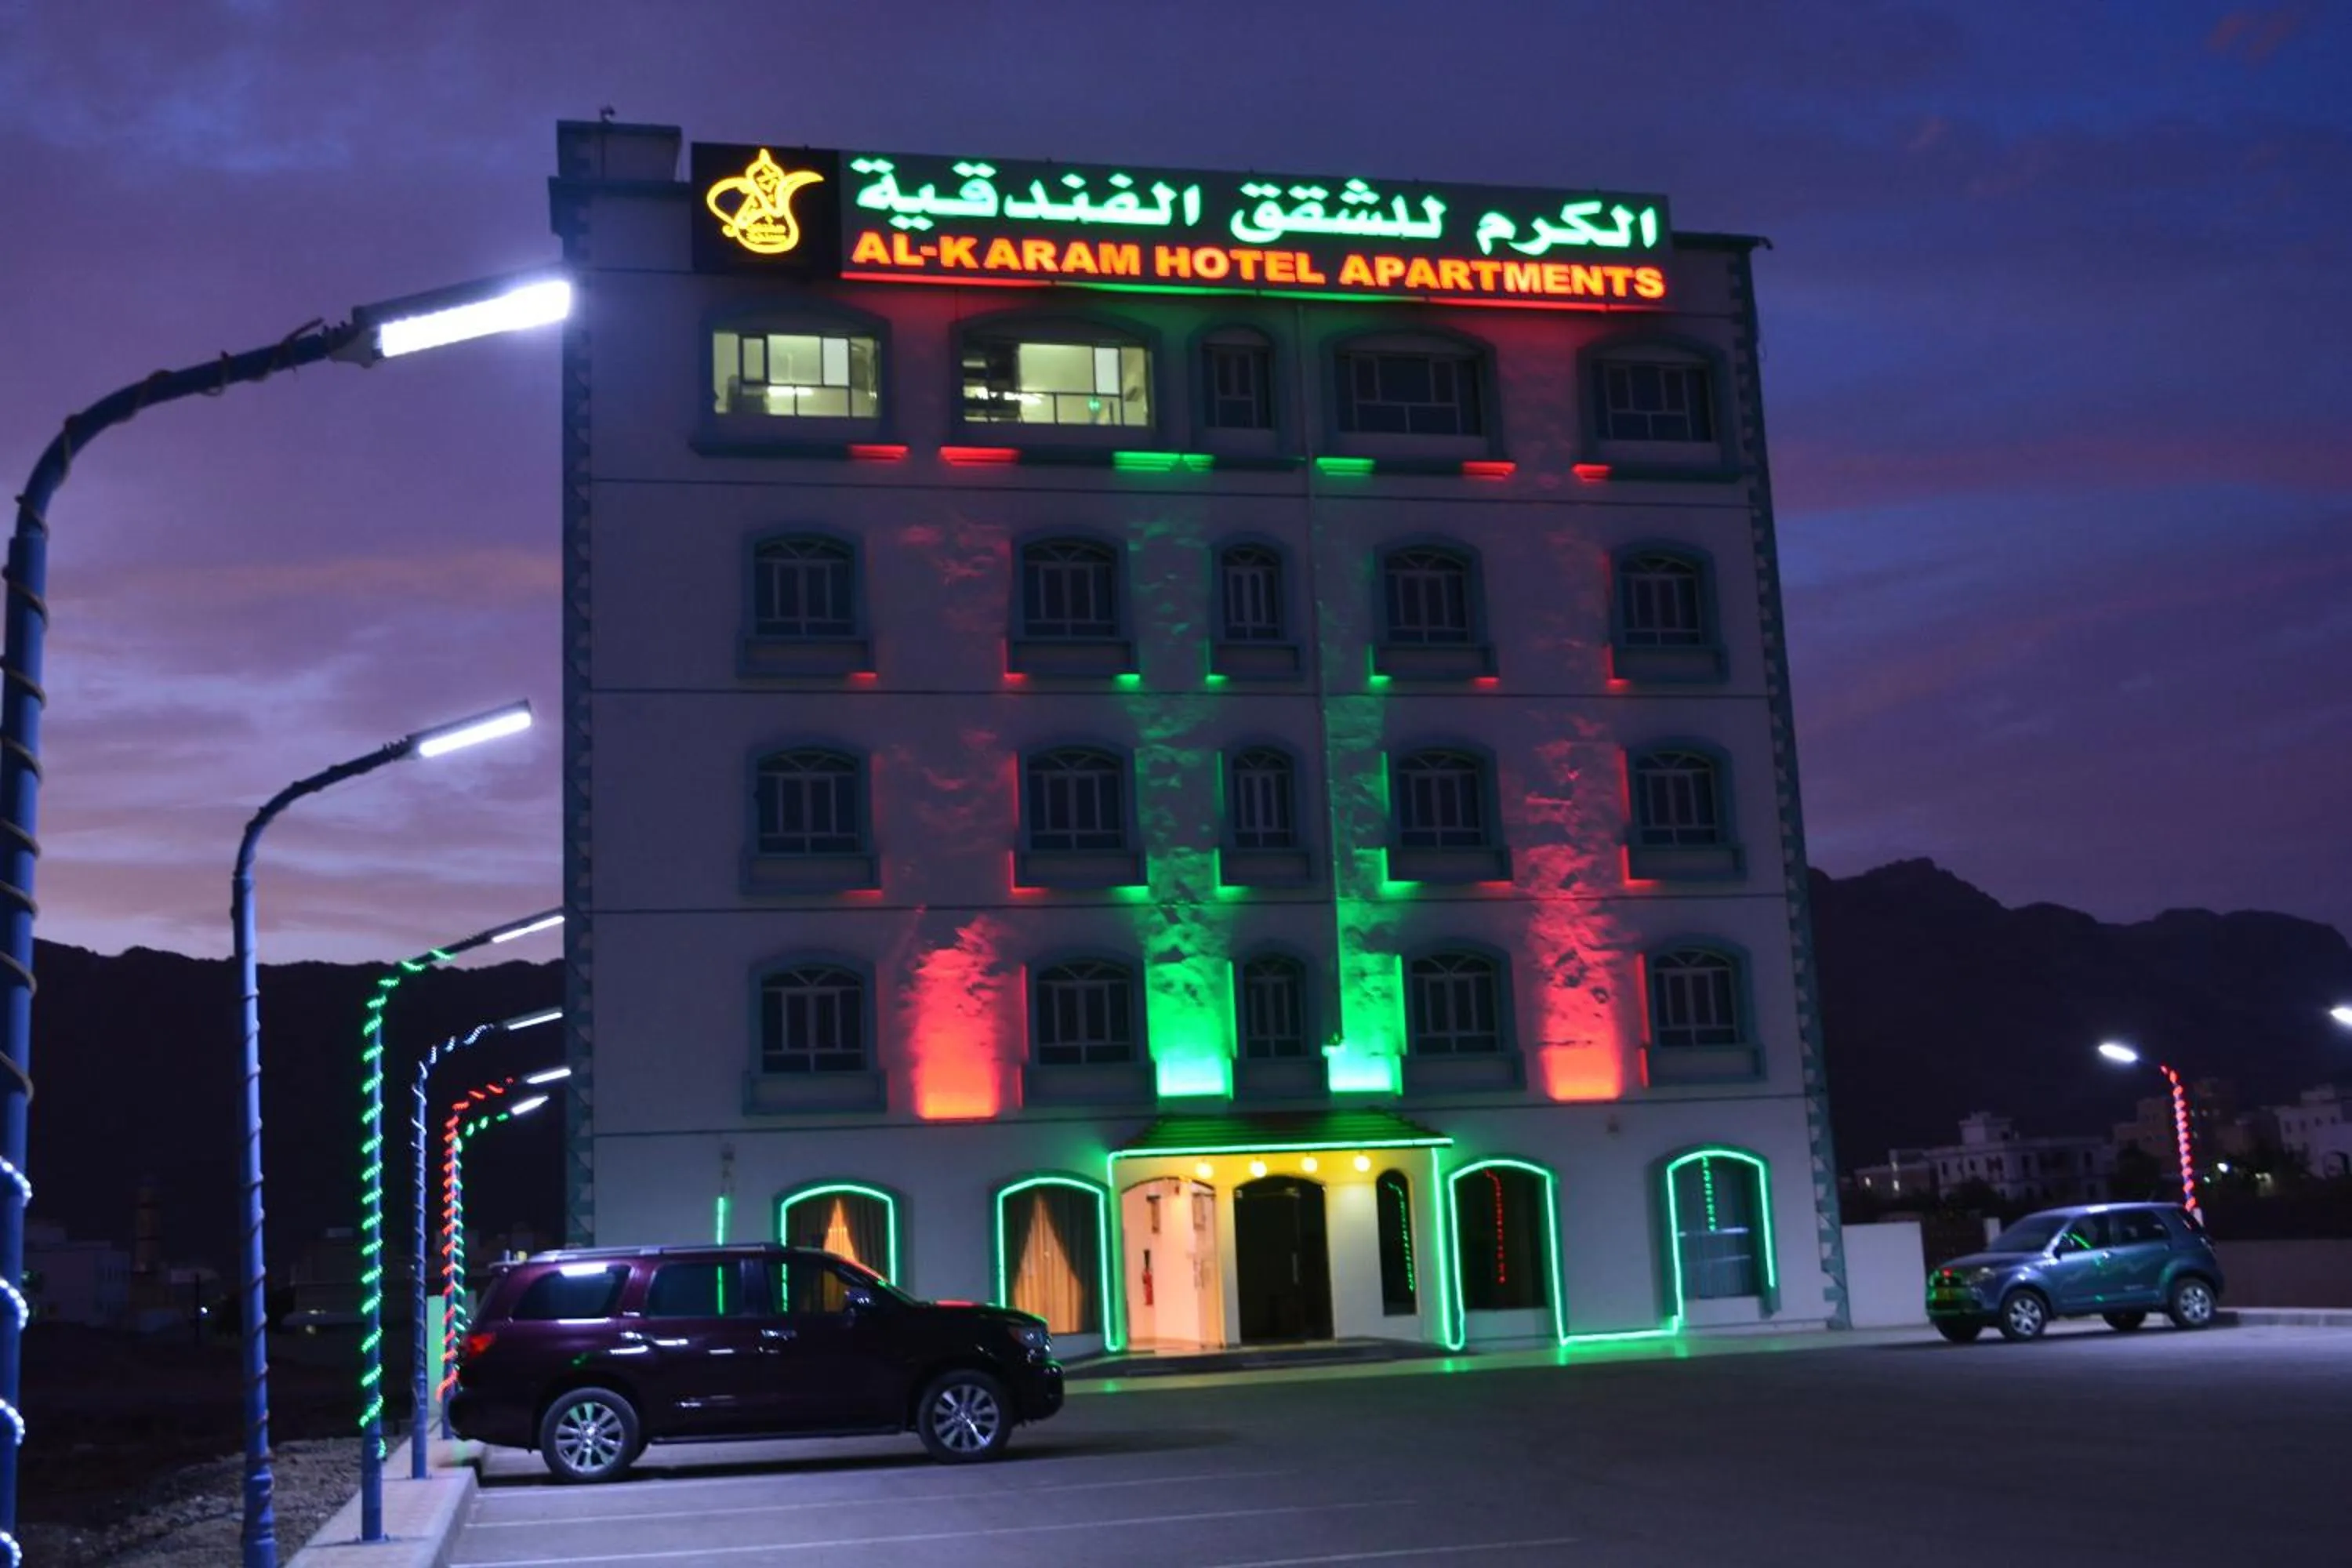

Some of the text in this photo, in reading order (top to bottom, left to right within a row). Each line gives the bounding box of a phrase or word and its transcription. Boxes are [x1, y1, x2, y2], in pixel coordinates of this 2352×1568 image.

[850, 158, 1202, 231] الفندقية
[1229, 178, 1447, 245] للشقق
[1475, 200, 1657, 256] الكرم
[852, 231, 1665, 299] AL-KARAM HOTEL APARTMENTS
